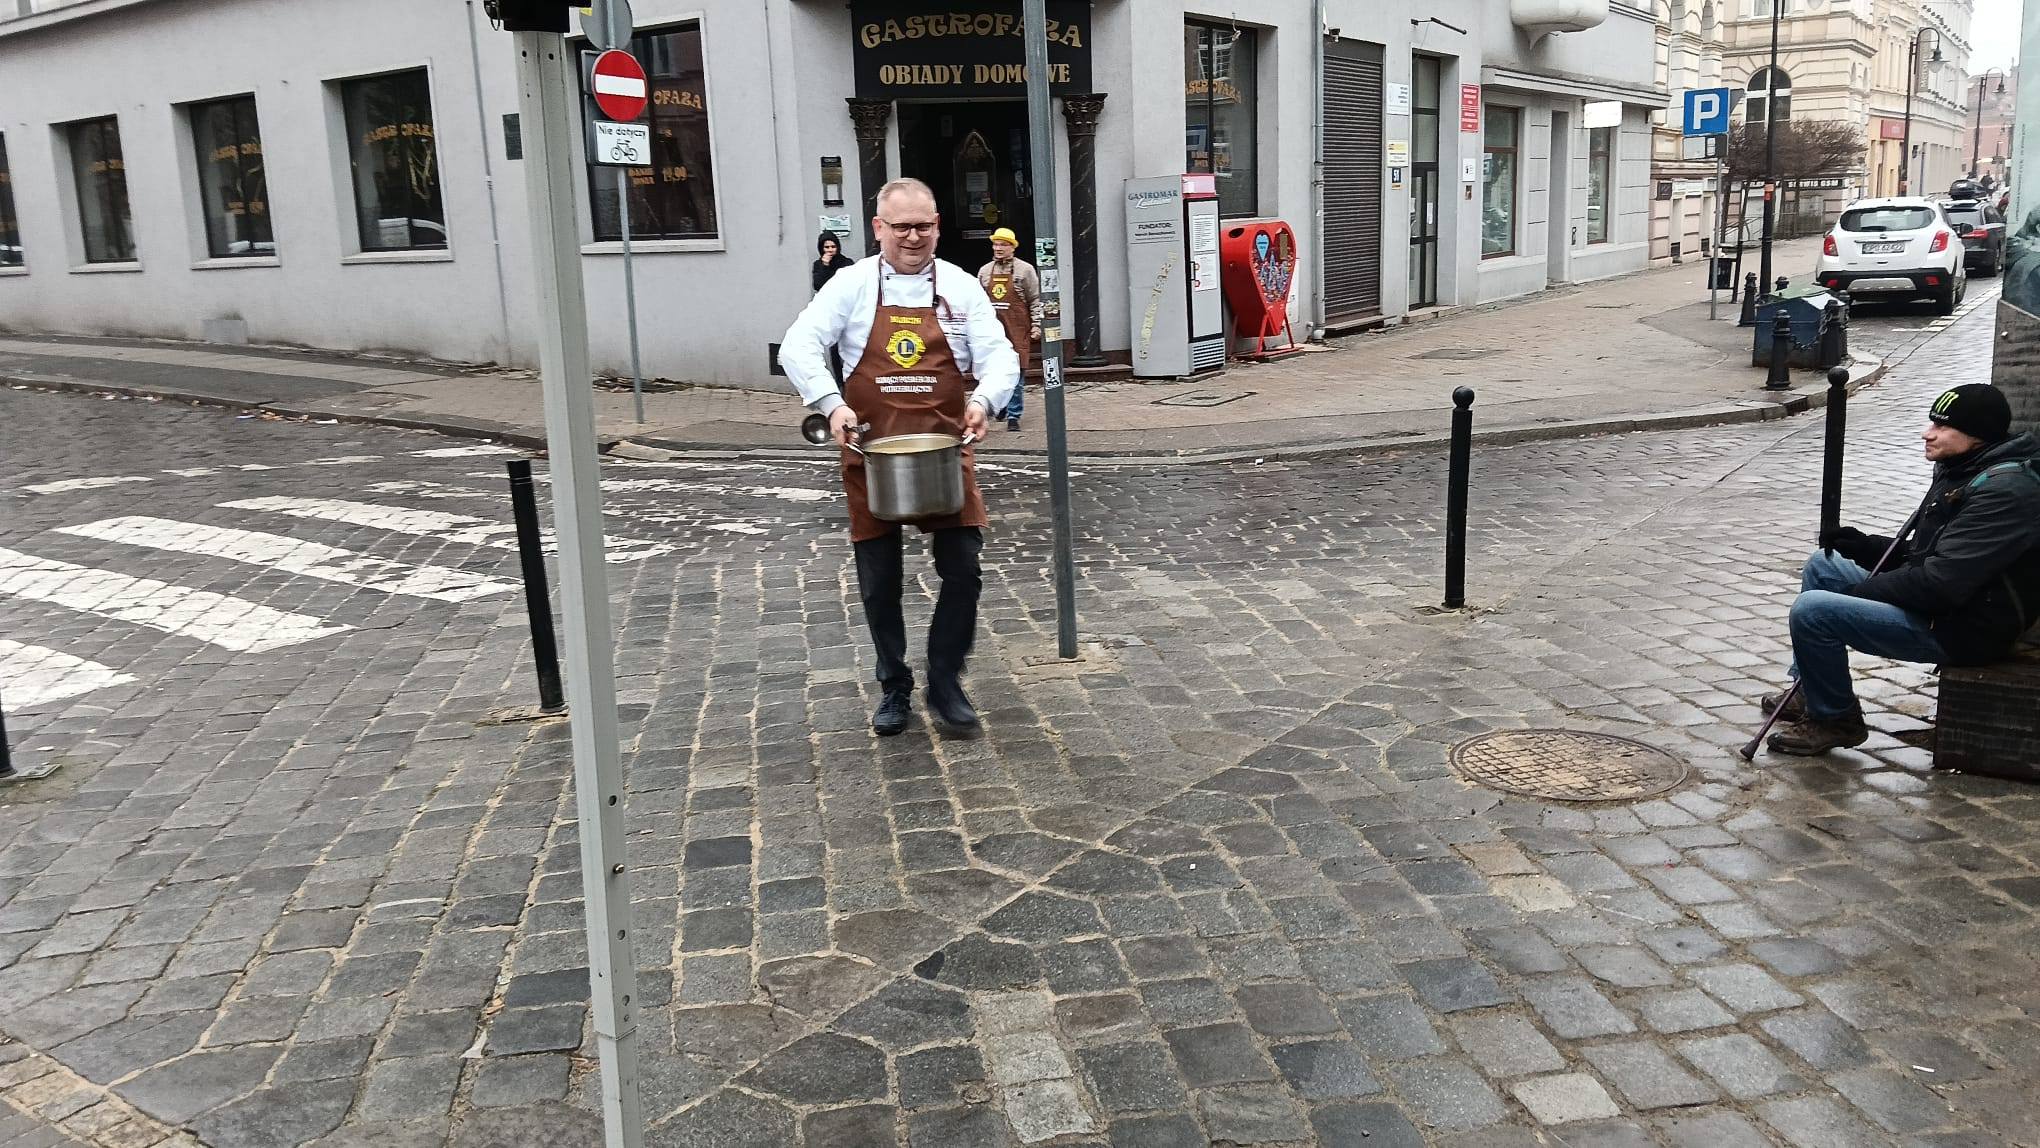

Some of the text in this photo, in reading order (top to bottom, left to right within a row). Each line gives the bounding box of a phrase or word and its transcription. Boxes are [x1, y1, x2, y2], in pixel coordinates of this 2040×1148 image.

[879, 64, 964, 85] OBIADY
[1693, 94, 1720, 130] P
[598, 124, 613, 135] Nie
[616, 126, 646, 139] dotyczy
